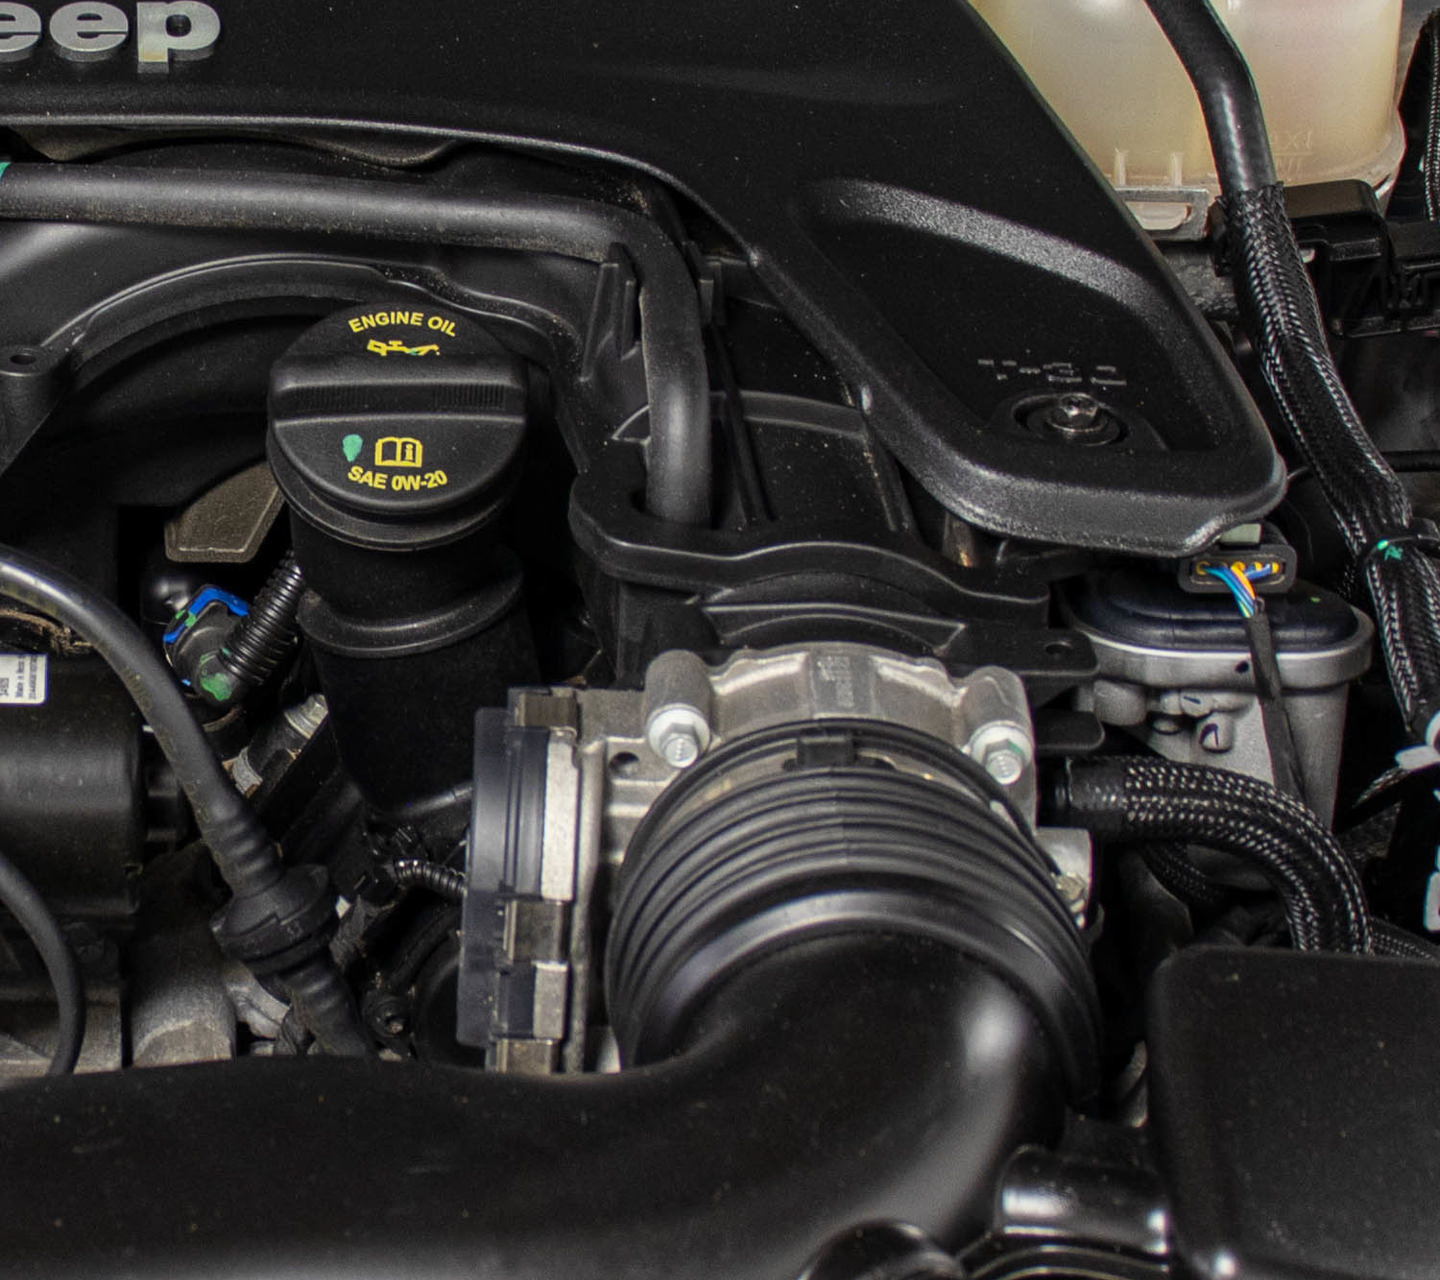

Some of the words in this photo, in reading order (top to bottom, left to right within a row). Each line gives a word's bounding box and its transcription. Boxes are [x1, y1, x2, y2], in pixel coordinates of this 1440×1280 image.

[348, 311, 424, 333] ENGINE
[428, 314, 457, 337] OIL
[348, 465, 386, 490] SAE
[392, 470, 447, 491] 0W-20
